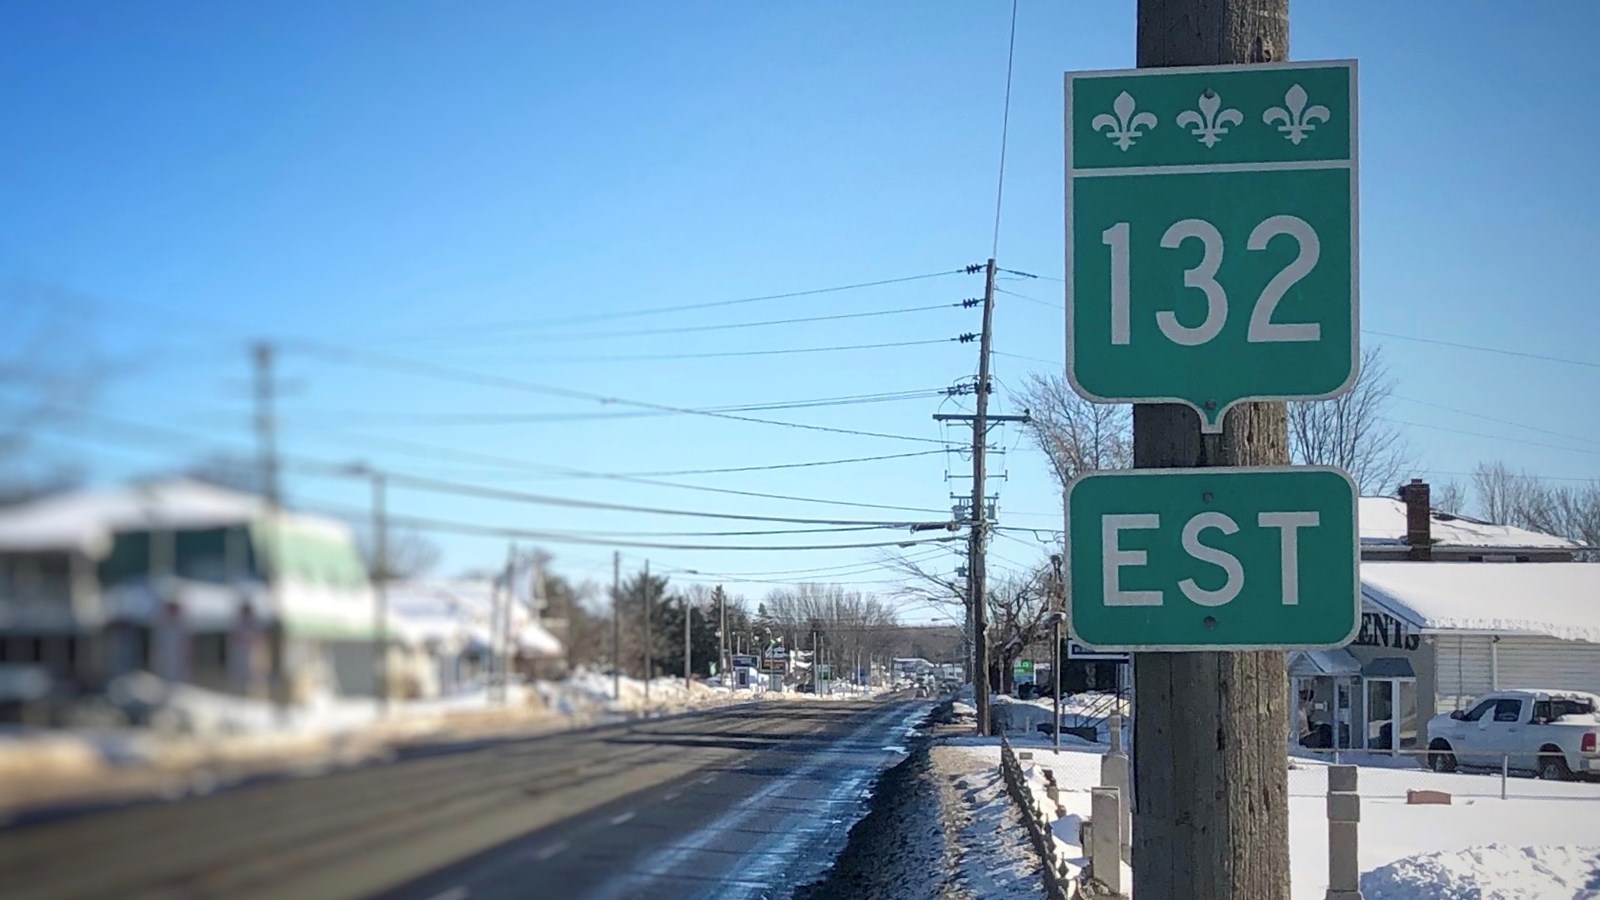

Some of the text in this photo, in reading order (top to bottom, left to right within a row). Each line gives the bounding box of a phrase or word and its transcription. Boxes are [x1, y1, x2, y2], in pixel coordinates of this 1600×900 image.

[1102, 214, 1321, 346] 132
[1101, 511, 1320, 607] EST
[1352, 611, 1420, 651] ENTS
